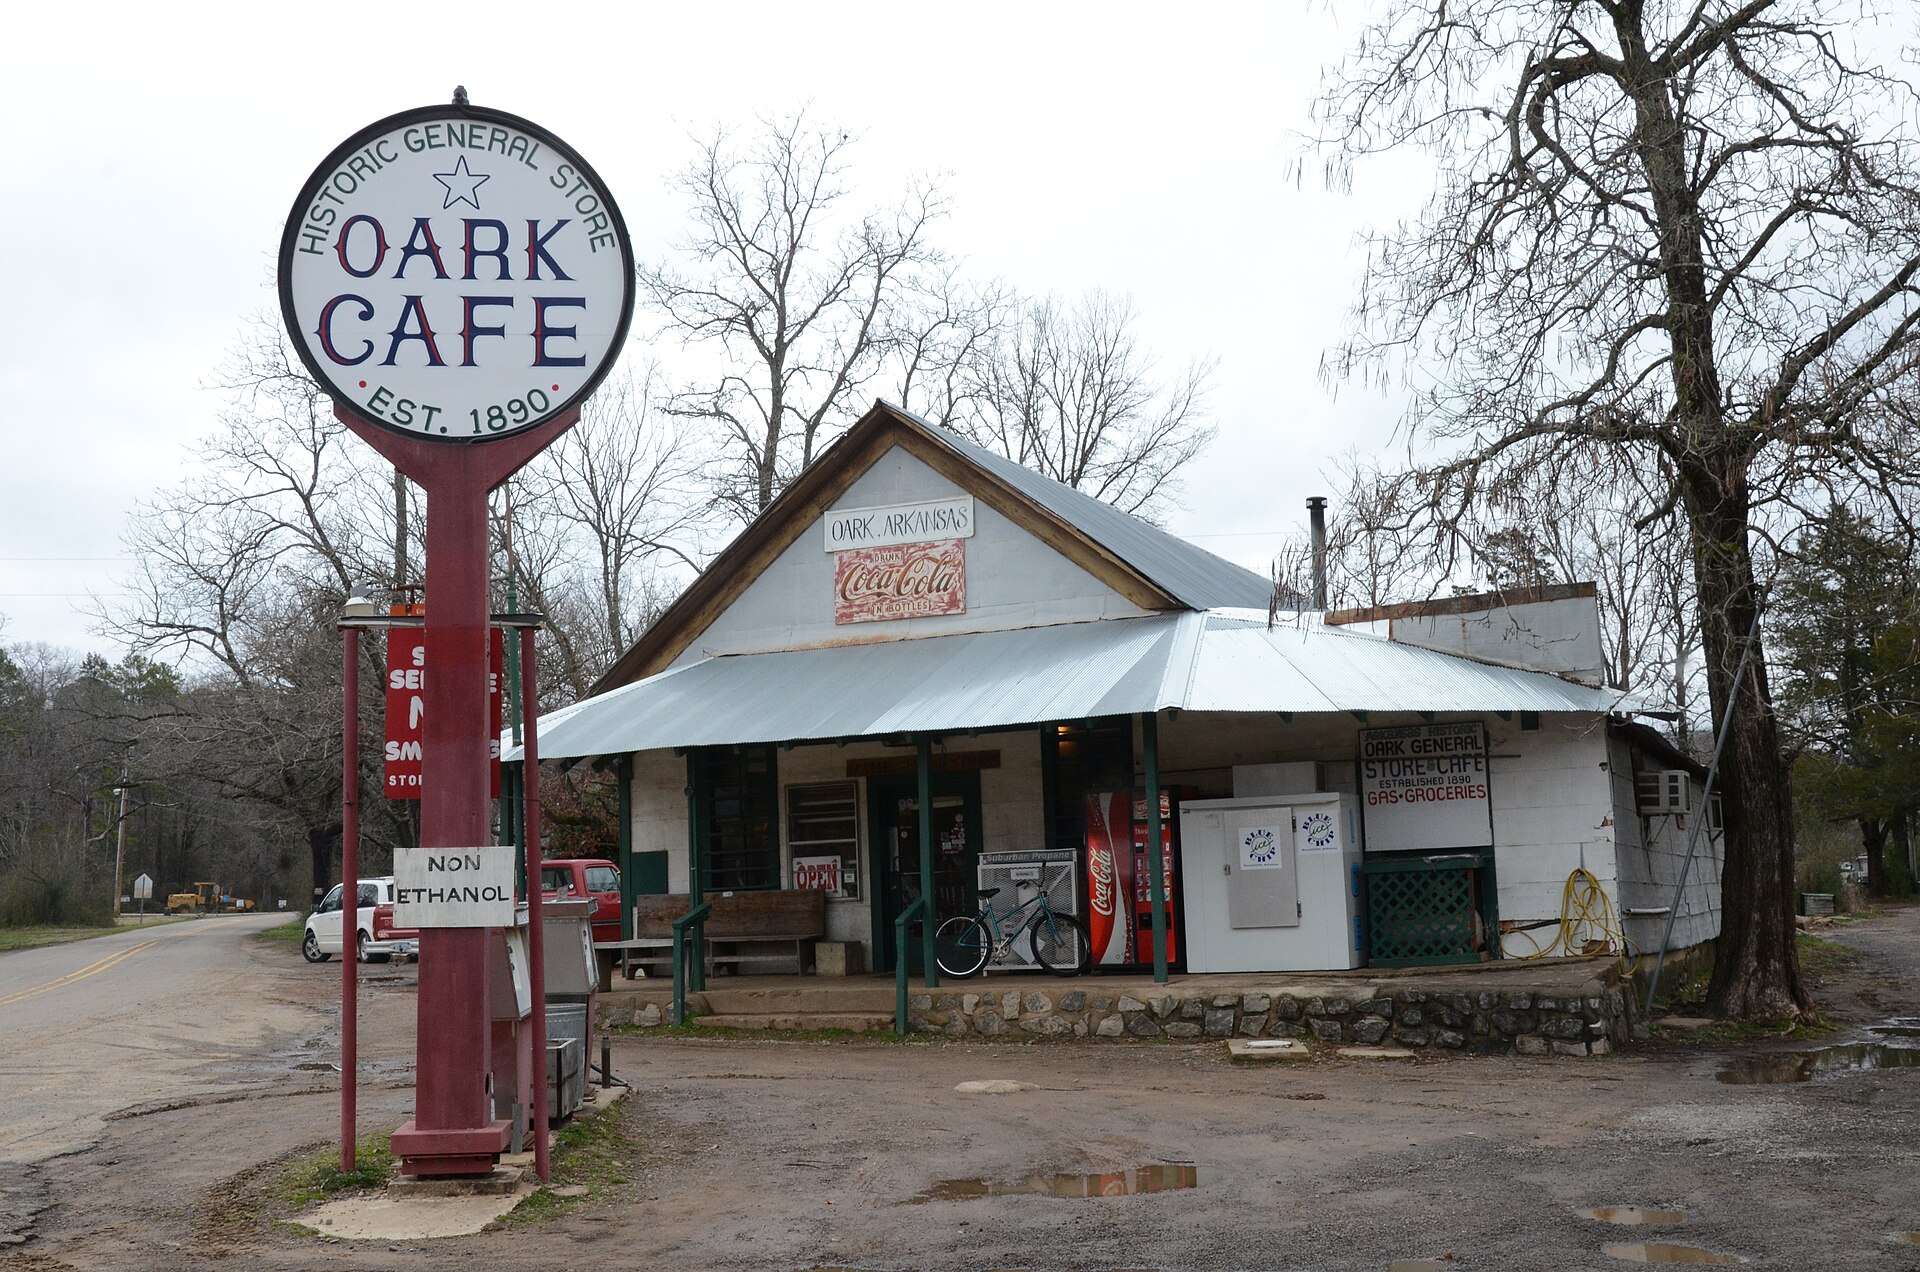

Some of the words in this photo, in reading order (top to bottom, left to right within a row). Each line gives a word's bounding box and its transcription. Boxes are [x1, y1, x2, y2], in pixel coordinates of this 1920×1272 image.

[299, 139, 398, 255] HISTORIC
[403, 123, 539, 170] GENERAL
[549, 163, 616, 254] STORE
[333, 213, 578, 280] OARK
[314, 294, 587, 367] CAFE
[366, 385, 448, 434] EST.
[470, 388, 550, 434] 1890
[883, 506, 968, 537] ARKANSAS
[874, 552, 901, 563] DRINK
[872, 604, 882, 614] IN
[888, 602, 928, 613] BOTTLES
[1365, 740, 1405, 757] OARK
[1411, 735, 1483, 754] GENERAL
[1366, 758, 1426, 778] STORE
[1437, 753, 1484, 774] CAFE
[1379, 776, 1444, 789] ESTABLISHED
[1447, 775, 1471, 784] 1890
[1302, 813, 1331, 830] BLUE
[1244, 829, 1274, 846] BLUE
[1307, 830, 1335, 847] CHIP
[428, 854, 481, 873] NON
[986, 853, 1029, 862] Suburban
[1031, 852, 1070, 861] Propane
[1249, 846, 1276, 862] CHIP
[796, 863, 838, 890] OPEN
[397, 886, 510, 905] ETHANOL
